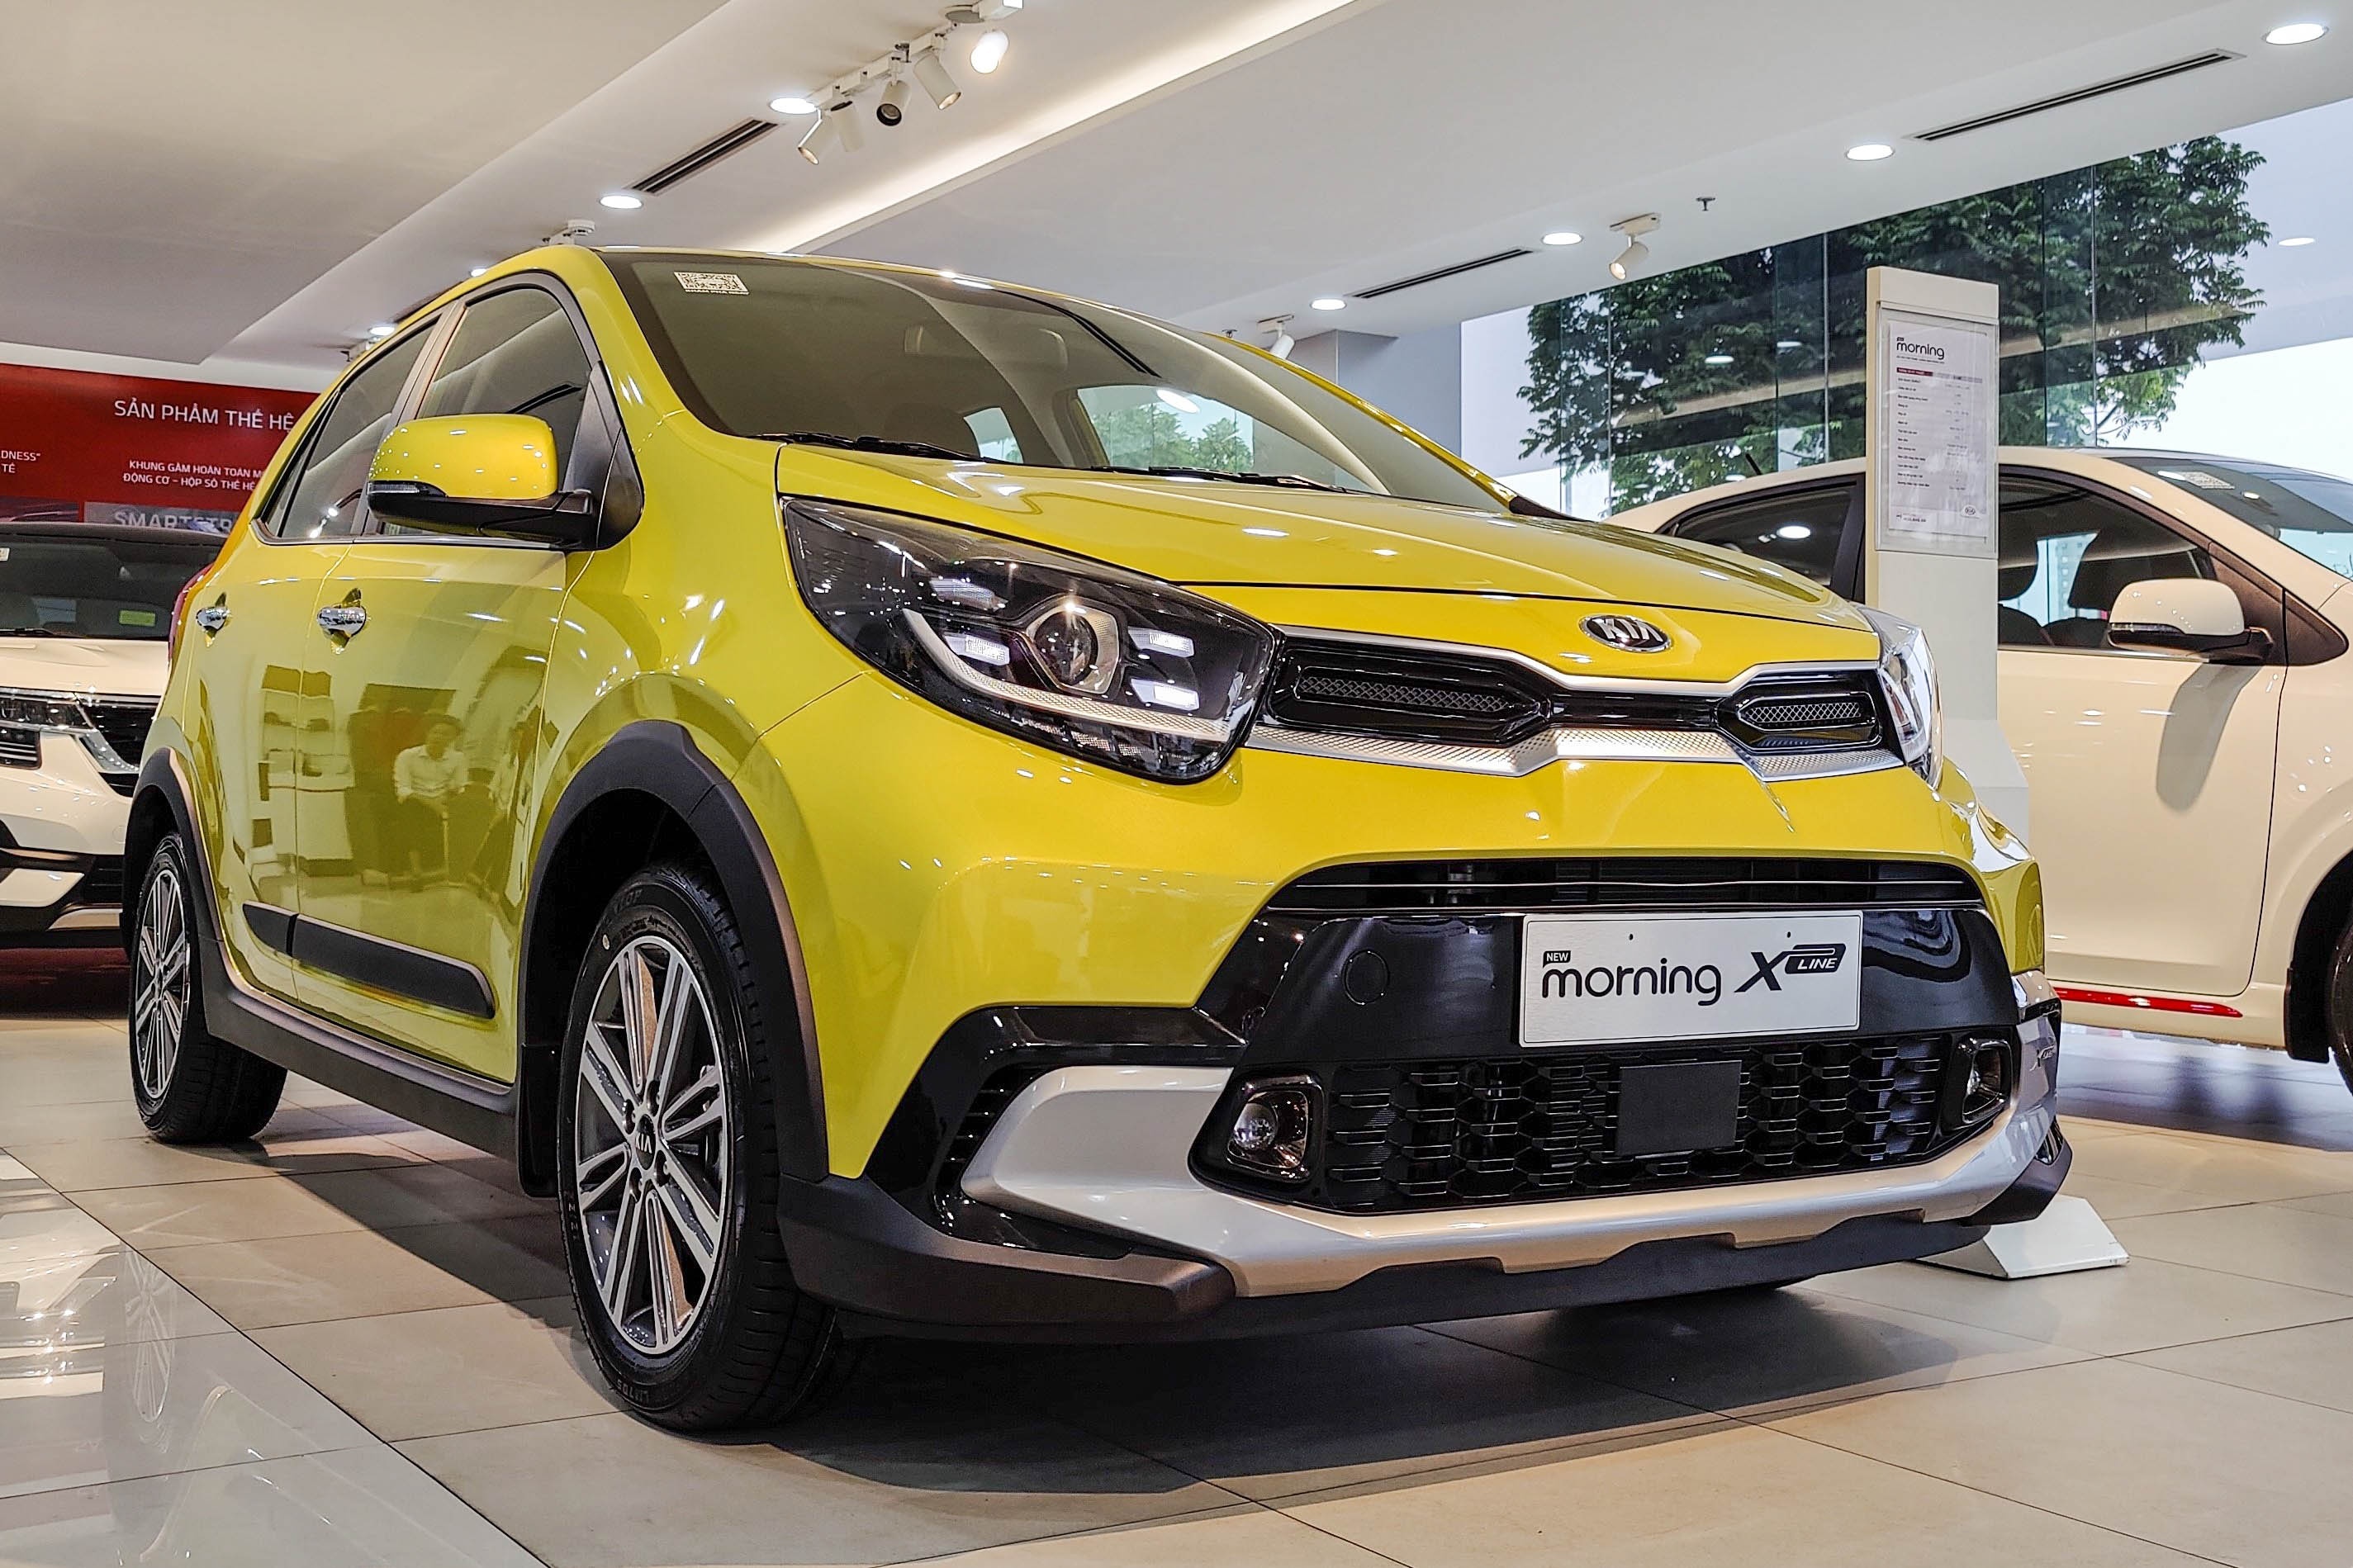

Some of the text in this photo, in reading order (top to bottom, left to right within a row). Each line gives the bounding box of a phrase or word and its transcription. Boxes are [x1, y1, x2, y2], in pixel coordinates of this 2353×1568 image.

[1896, 342, 1945, 360] morning
[114, 397, 154, 419] SẢN
[225, 409, 263, 429] THẾ
[269, 412, 296, 433] HỆ
[129, 460, 165, 471] KHUNG
[123, 472, 154, 484] ĐỘNG
[1546, 951, 1568, 962] NEW
[1541, 957, 1722, 1007] morning
[1796, 957, 1838, 970] LINE
[636, 1131, 652, 1153] KIA
